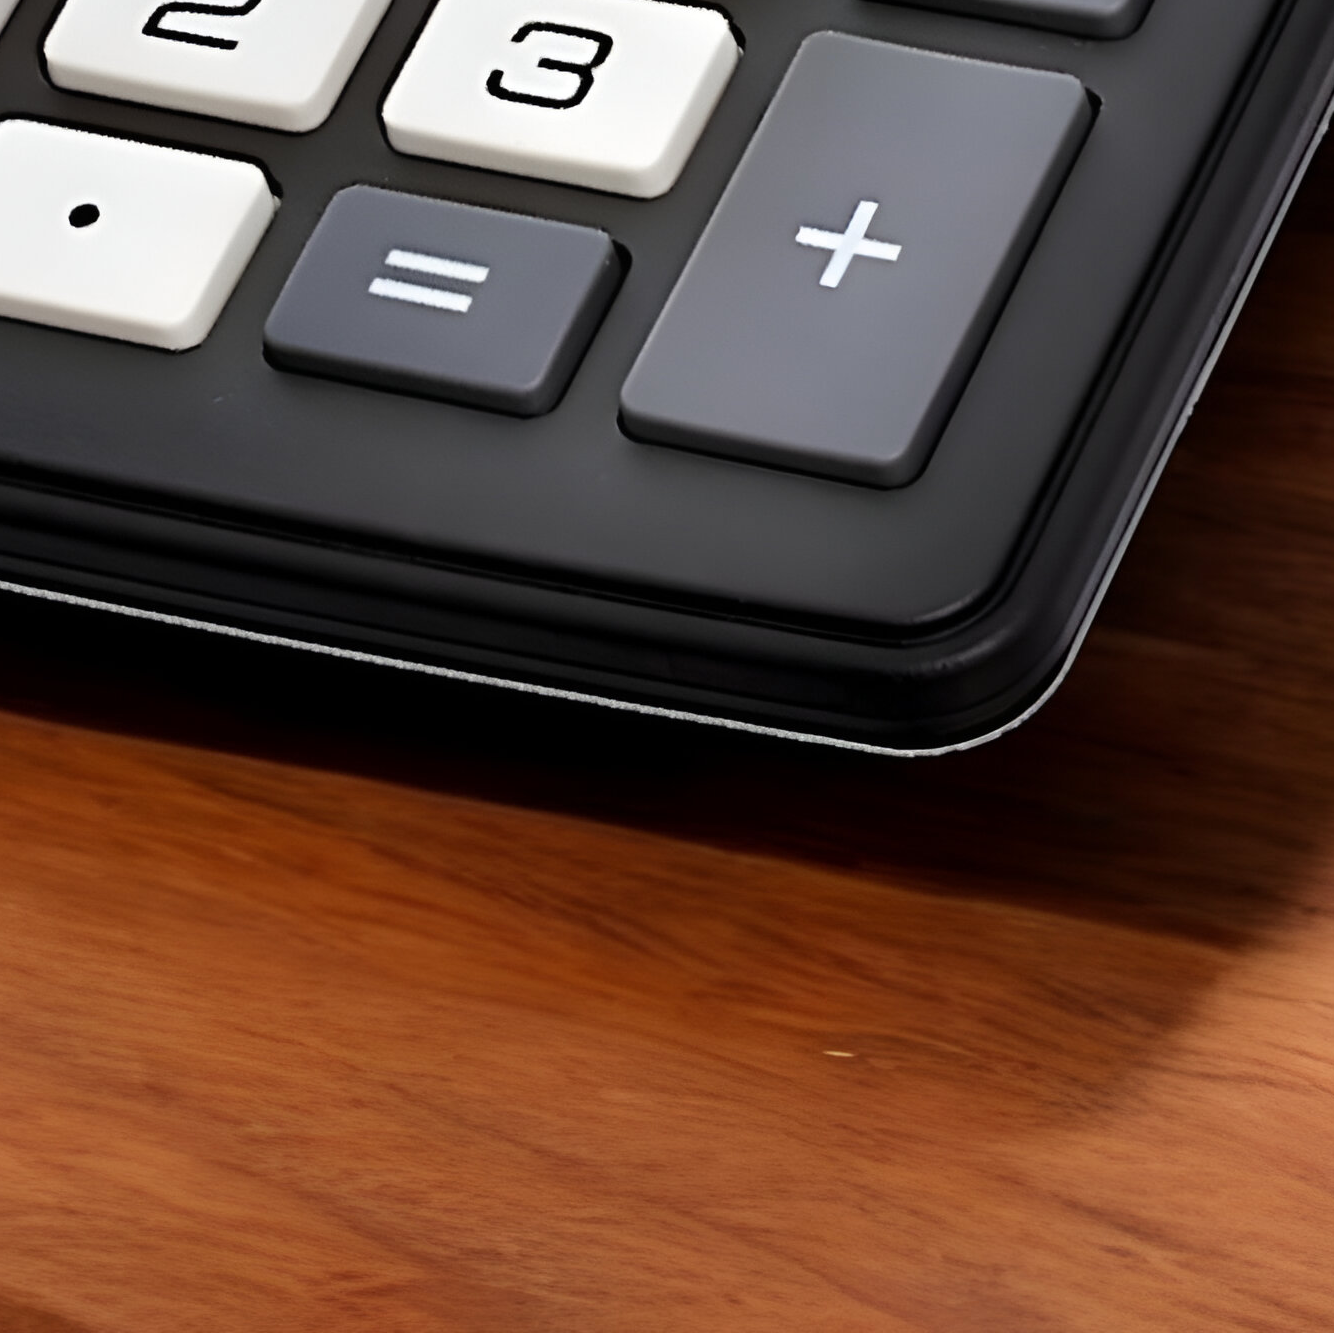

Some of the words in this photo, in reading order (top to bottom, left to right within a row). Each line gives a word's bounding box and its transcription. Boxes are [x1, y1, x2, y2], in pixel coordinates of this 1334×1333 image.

[485, 21, 614, 110] 3
[368, 249, 490, 313] =
[795, 200, 903, 288] +
